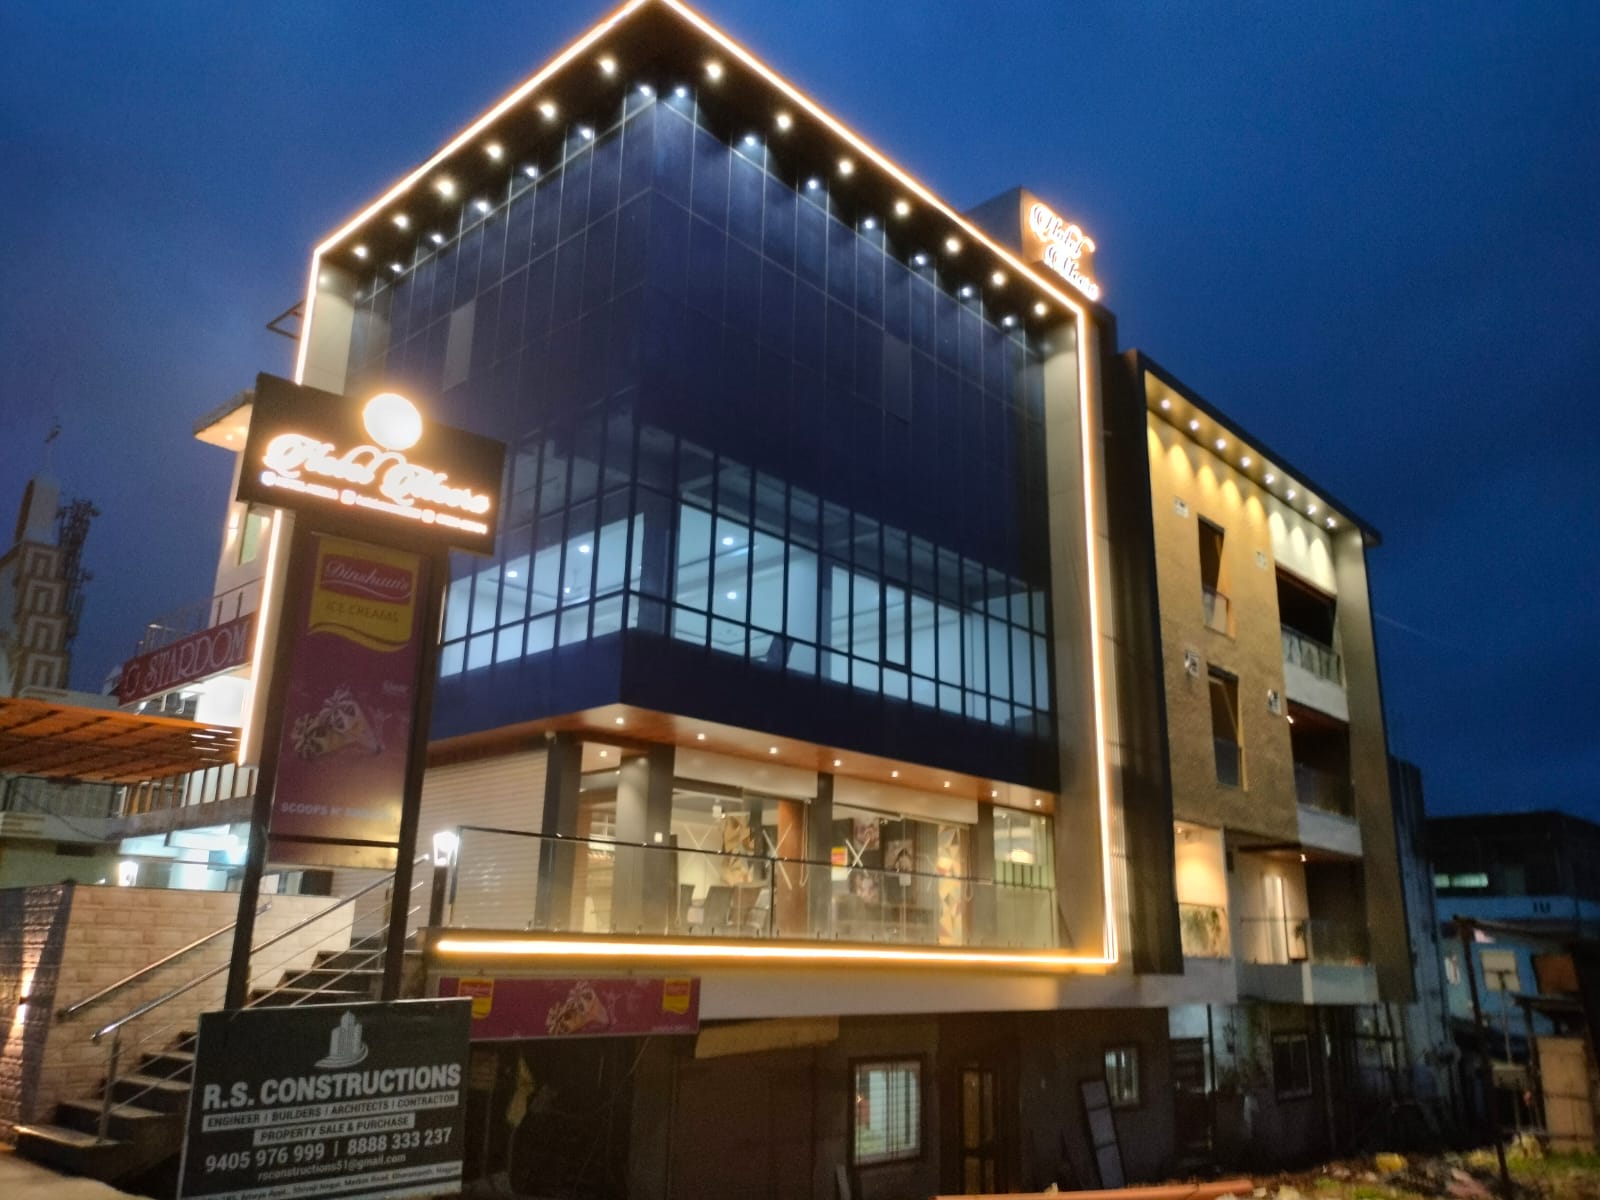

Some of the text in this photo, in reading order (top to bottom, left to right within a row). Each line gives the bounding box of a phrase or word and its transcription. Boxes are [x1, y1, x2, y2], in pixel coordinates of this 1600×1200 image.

[327, 600, 400, 623] ICE CREAMS
[144, 622, 249, 692] STARDOM
[202, 1063, 462, 1110] R.S. CONSTRUCTIONS
[207, 1113, 260, 1128] ENGINEER
[271, 1107, 321, 1121] BUILDERS
[331, 1100, 389, 1114] ARCHITECTS
[397, 1094, 456, 1108] CONTRACTOR
[261, 1116, 409, 1142] PROPERTY SALE & PURCHASE
[205, 1151, 251, 1173] 9405
[255, 1147, 289, 1168] 976
[293, 1143, 326, 1162] 999
[347, 1135, 388, 1155] 8888
[391, 1131, 420, 1150] 333
[423, 1127, 453, 1146] 237
